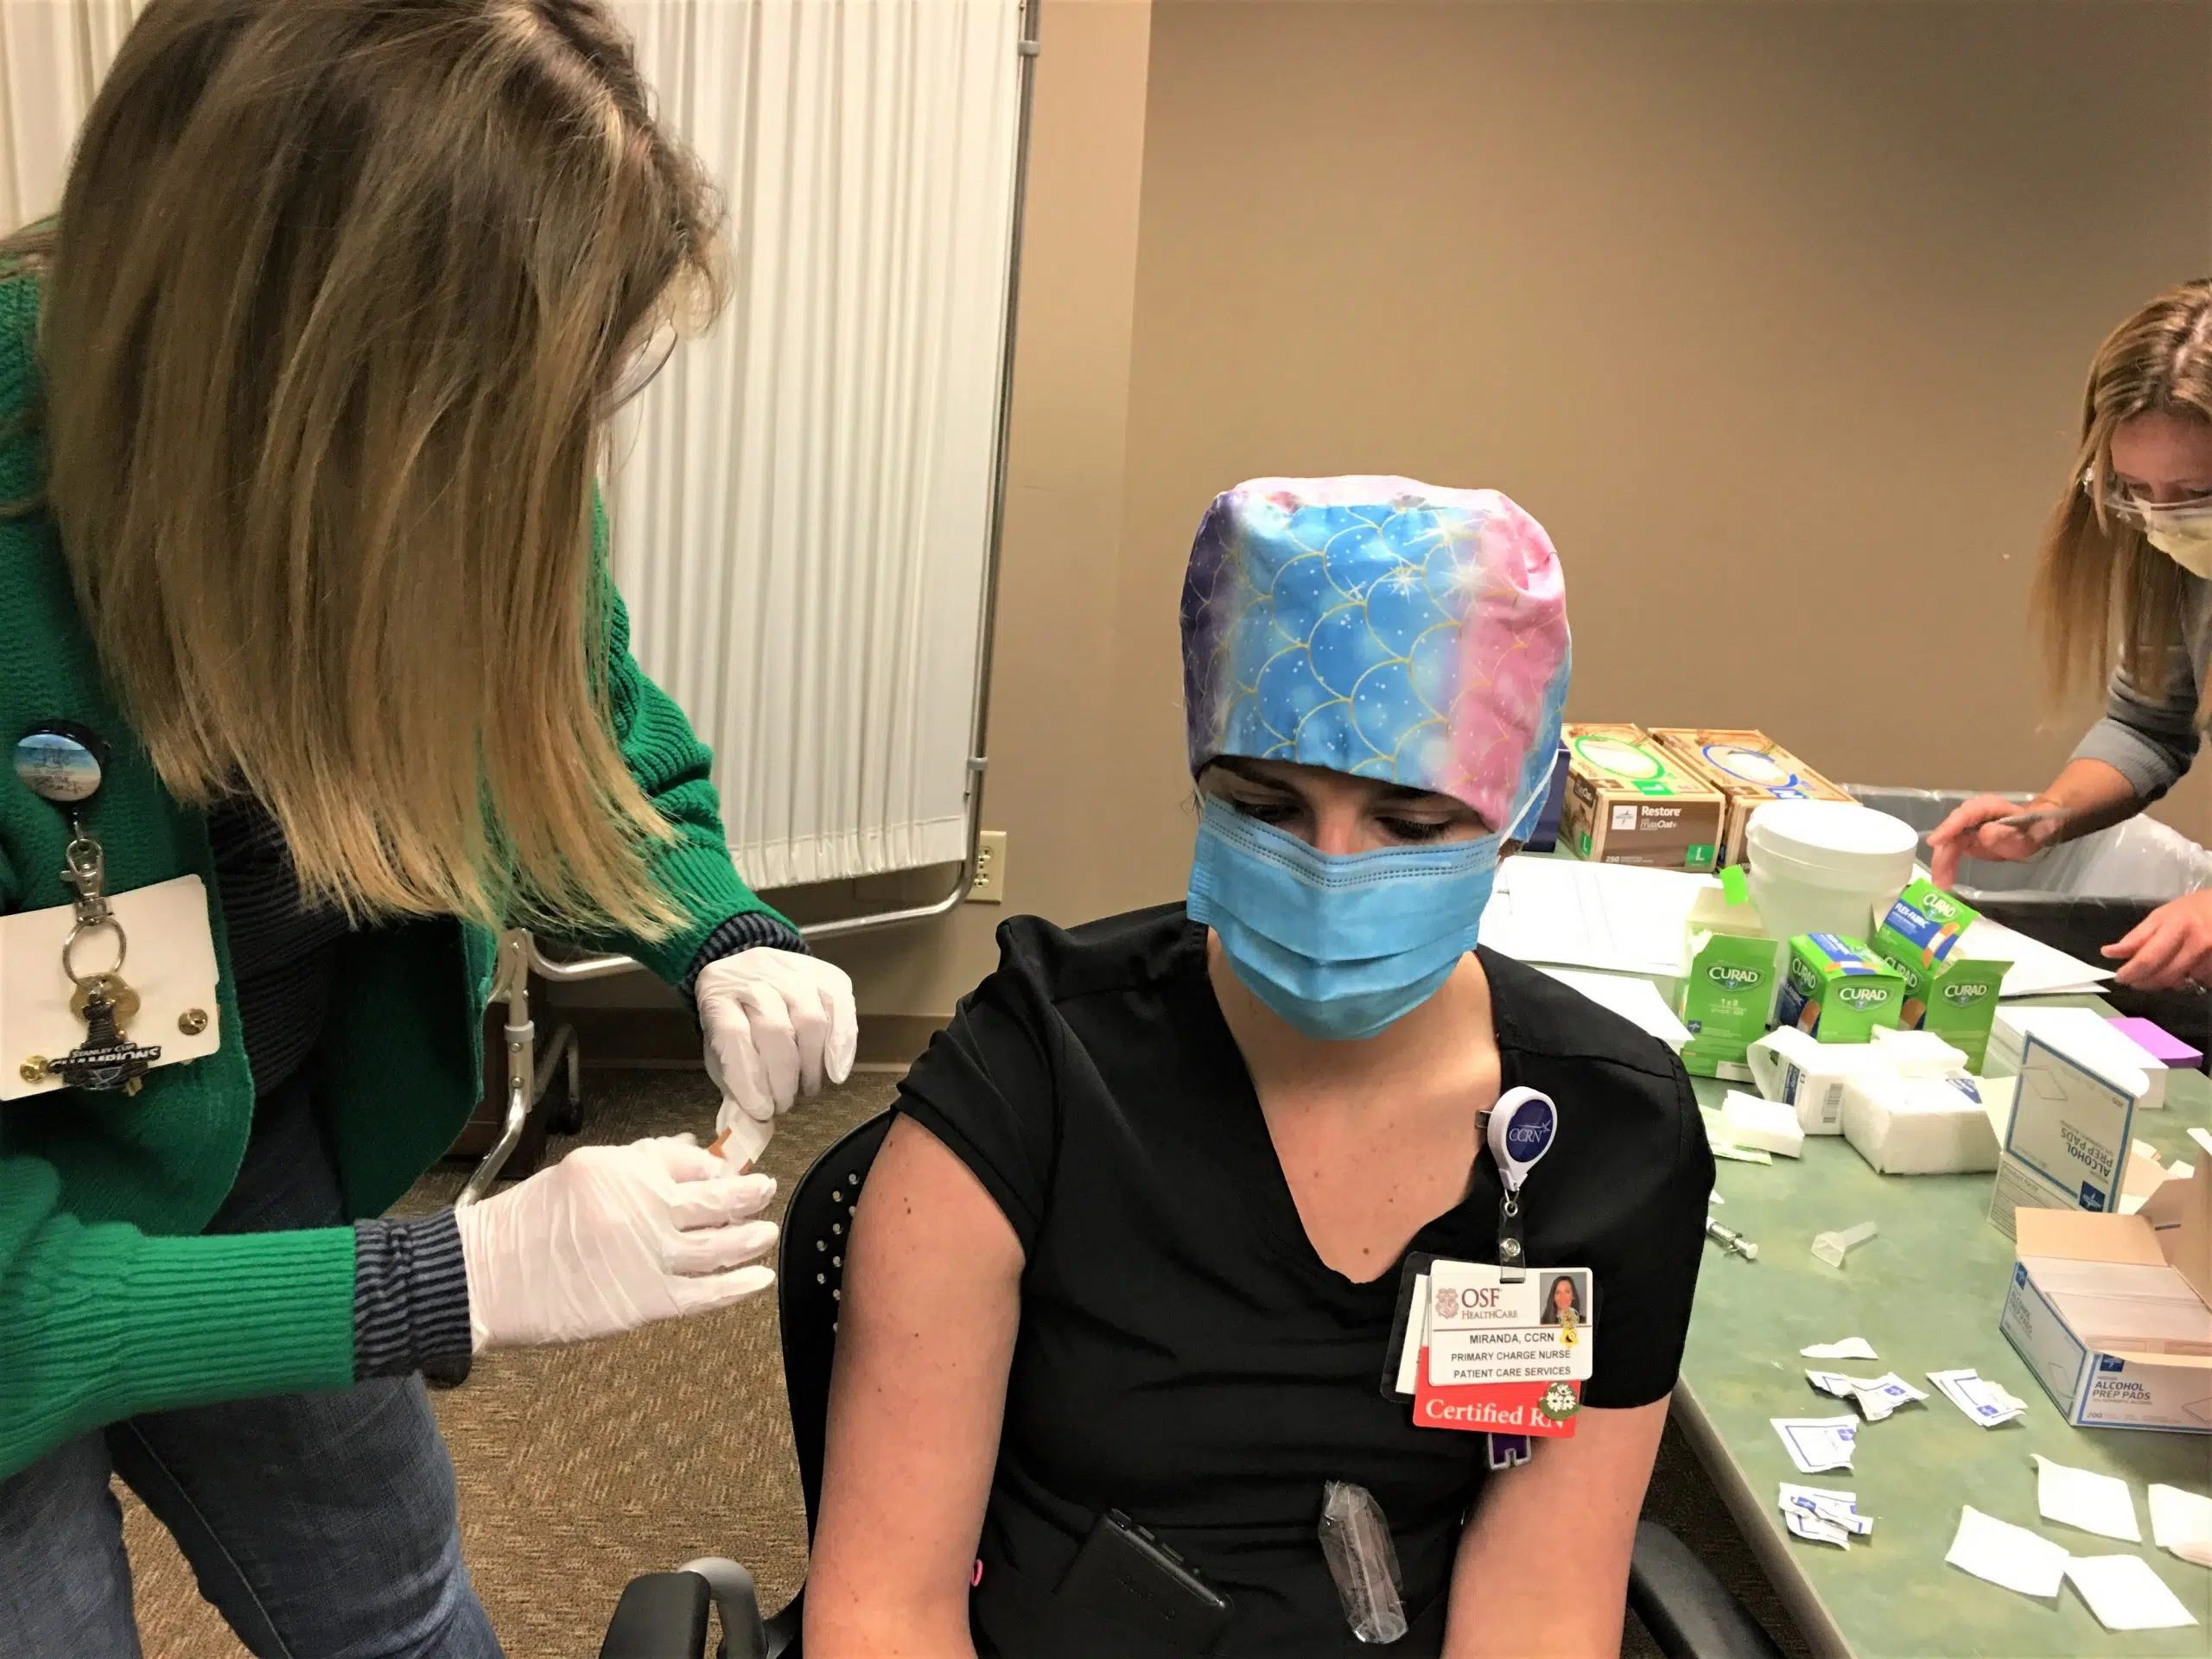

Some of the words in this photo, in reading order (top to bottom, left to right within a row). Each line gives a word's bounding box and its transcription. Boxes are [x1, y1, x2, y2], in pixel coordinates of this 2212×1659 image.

[1642, 805, 1681, 817] Restore
[1695, 847, 1705, 861] L
[1923, 893, 1956, 918] CURAD
[1709, 967, 1758, 982] CURAD
[1792, 957, 1816, 988] CURAD
[1840, 988, 1887, 1001] CURAD
[1944, 985, 1987, 997] CURAD
[49, 1046, 160, 1068] CPIONS
[1509, 1128, 1542, 1142] CCRN
[2061, 1127, 2087, 1151] PADS
[2066, 1141, 2111, 1177] ALCOHOL
[2088, 1148, 2113, 1167] PREP
[1461, 1288, 1500, 1307] OSF
[1470, 1333, 1521, 1344] MIRANDA,
[1524, 1332, 1554, 1343] CCRN
[1451, 1352, 1494, 1362] PRIMARY
[1497, 1351, 1535, 1360] CHARGE
[1539, 1350, 1571, 1359] NURSE
[1453, 1369, 1493, 1378] PATIENT
[1496, 1368, 1522, 1377] CARE
[1524, 1367, 1571, 1376] SERVICES
[2094, 1381, 2145, 1391] ALCOHOL
[2122, 1391, 2152, 1401] PADS
[1426, 1398, 1522, 1426] Certified
